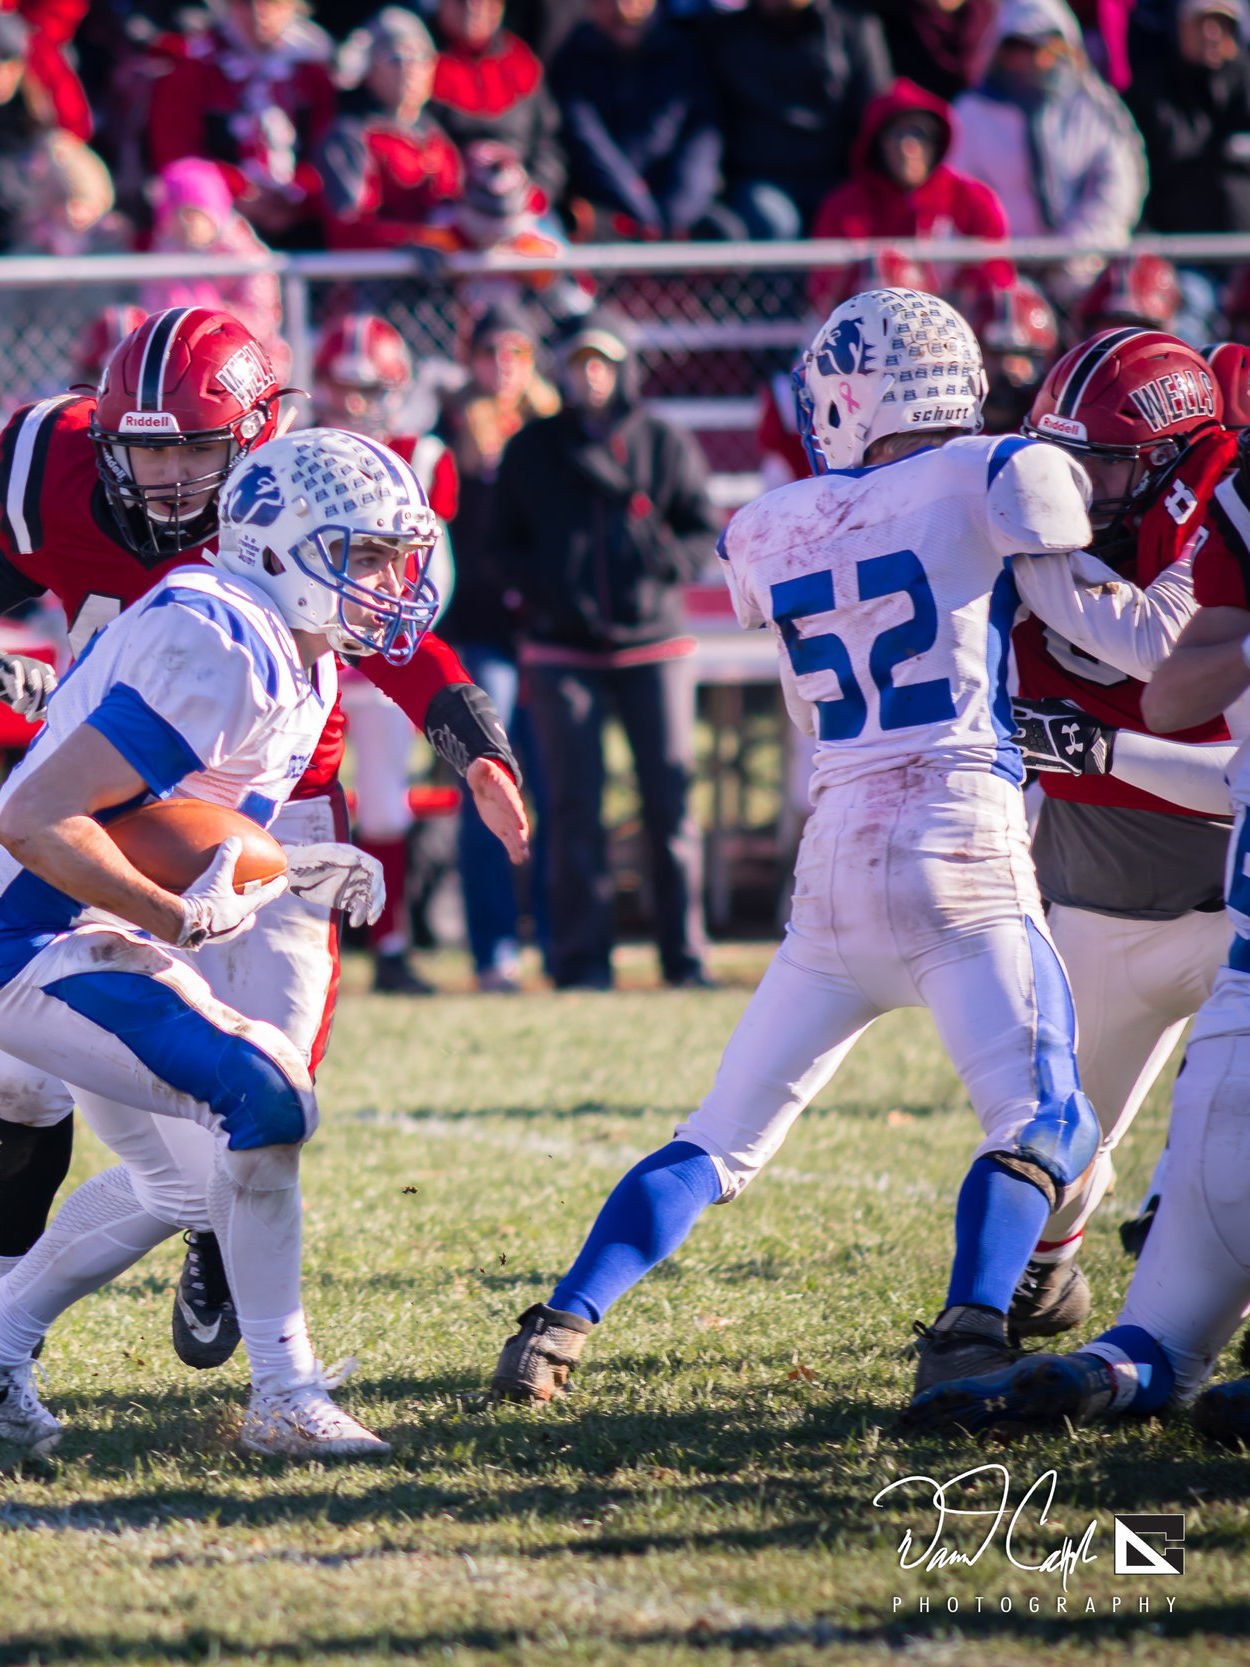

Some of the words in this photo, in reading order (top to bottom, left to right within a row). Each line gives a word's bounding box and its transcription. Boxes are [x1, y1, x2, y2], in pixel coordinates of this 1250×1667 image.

[1129, 370, 1216, 433] WELLS
[125, 415, 170, 428] Riddell
[912, 405, 969, 422] schutt
[1043, 416, 1080, 436] Riddell
[770, 549, 957, 741] 52
